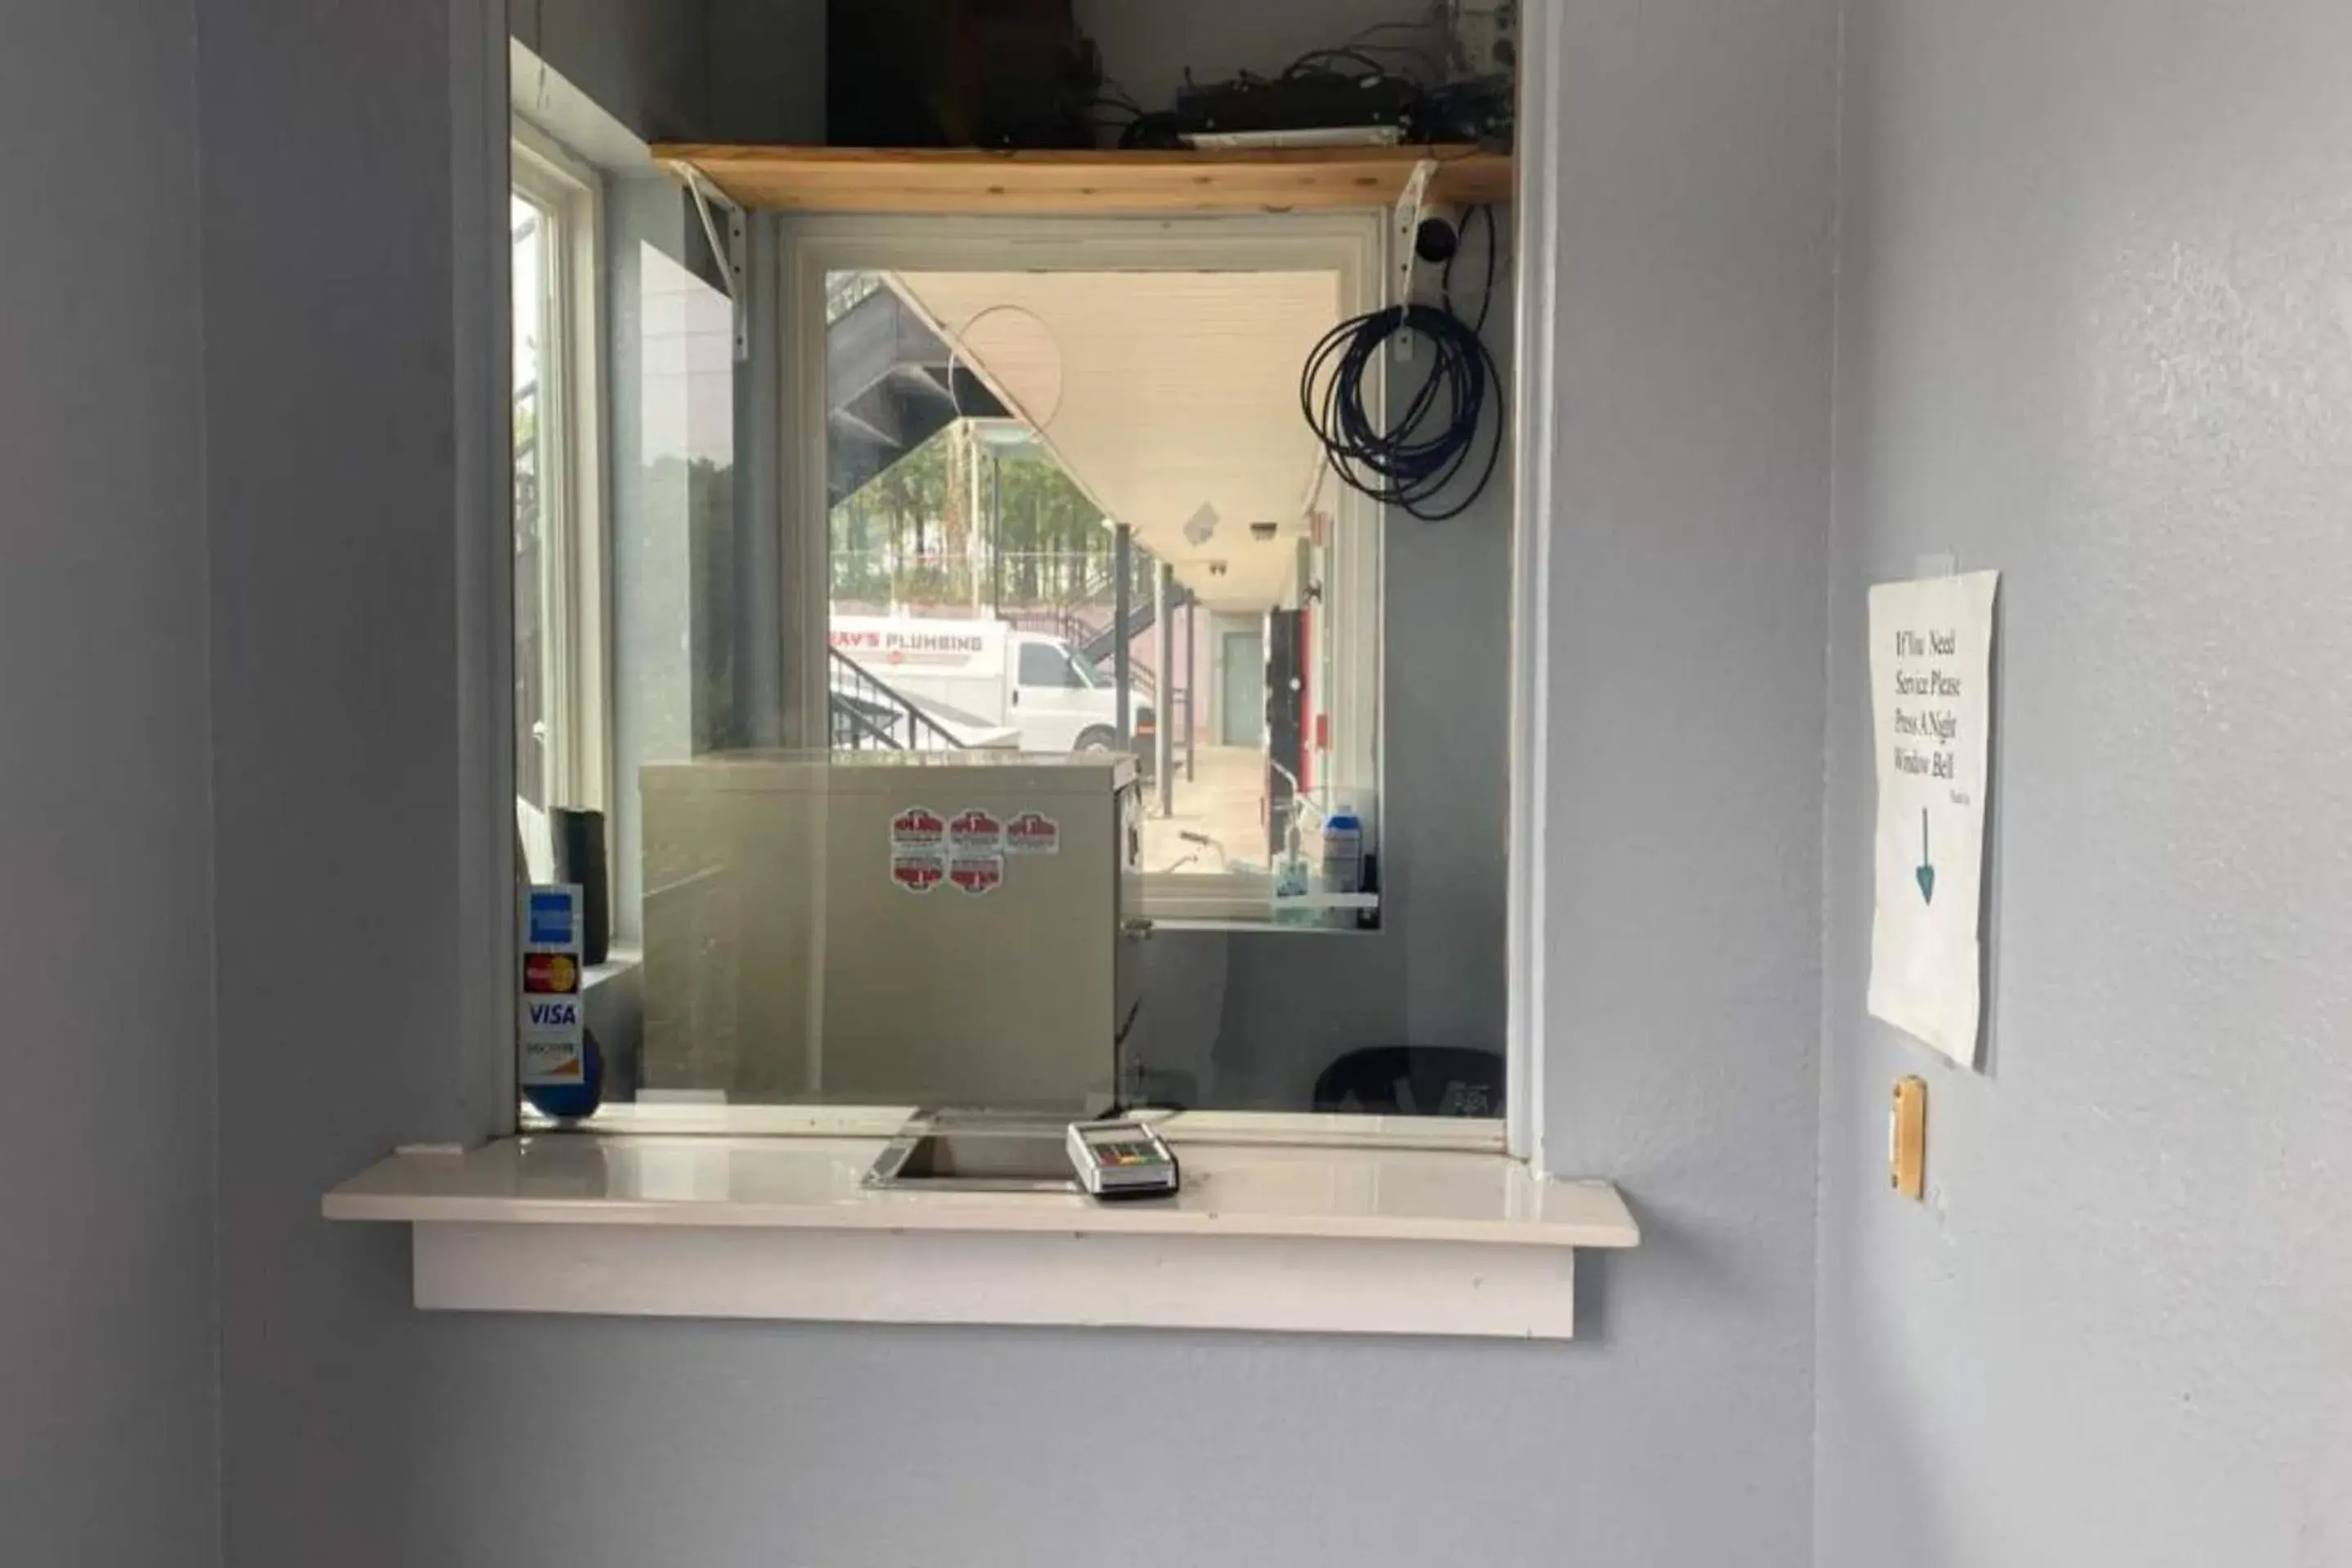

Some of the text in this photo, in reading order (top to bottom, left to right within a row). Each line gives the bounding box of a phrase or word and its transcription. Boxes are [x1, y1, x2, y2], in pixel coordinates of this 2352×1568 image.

[886, 632, 983, 652] PLUMBING
[1929, 628, 1955, 655] Need
[1895, 669, 1960, 696] Service Please
[1895, 707, 1918, 734] Press
[1928, 710, 1957, 738] Night
[1894, 746, 1953, 778] Window Bell
[530, 1004, 576, 1024] VISA
